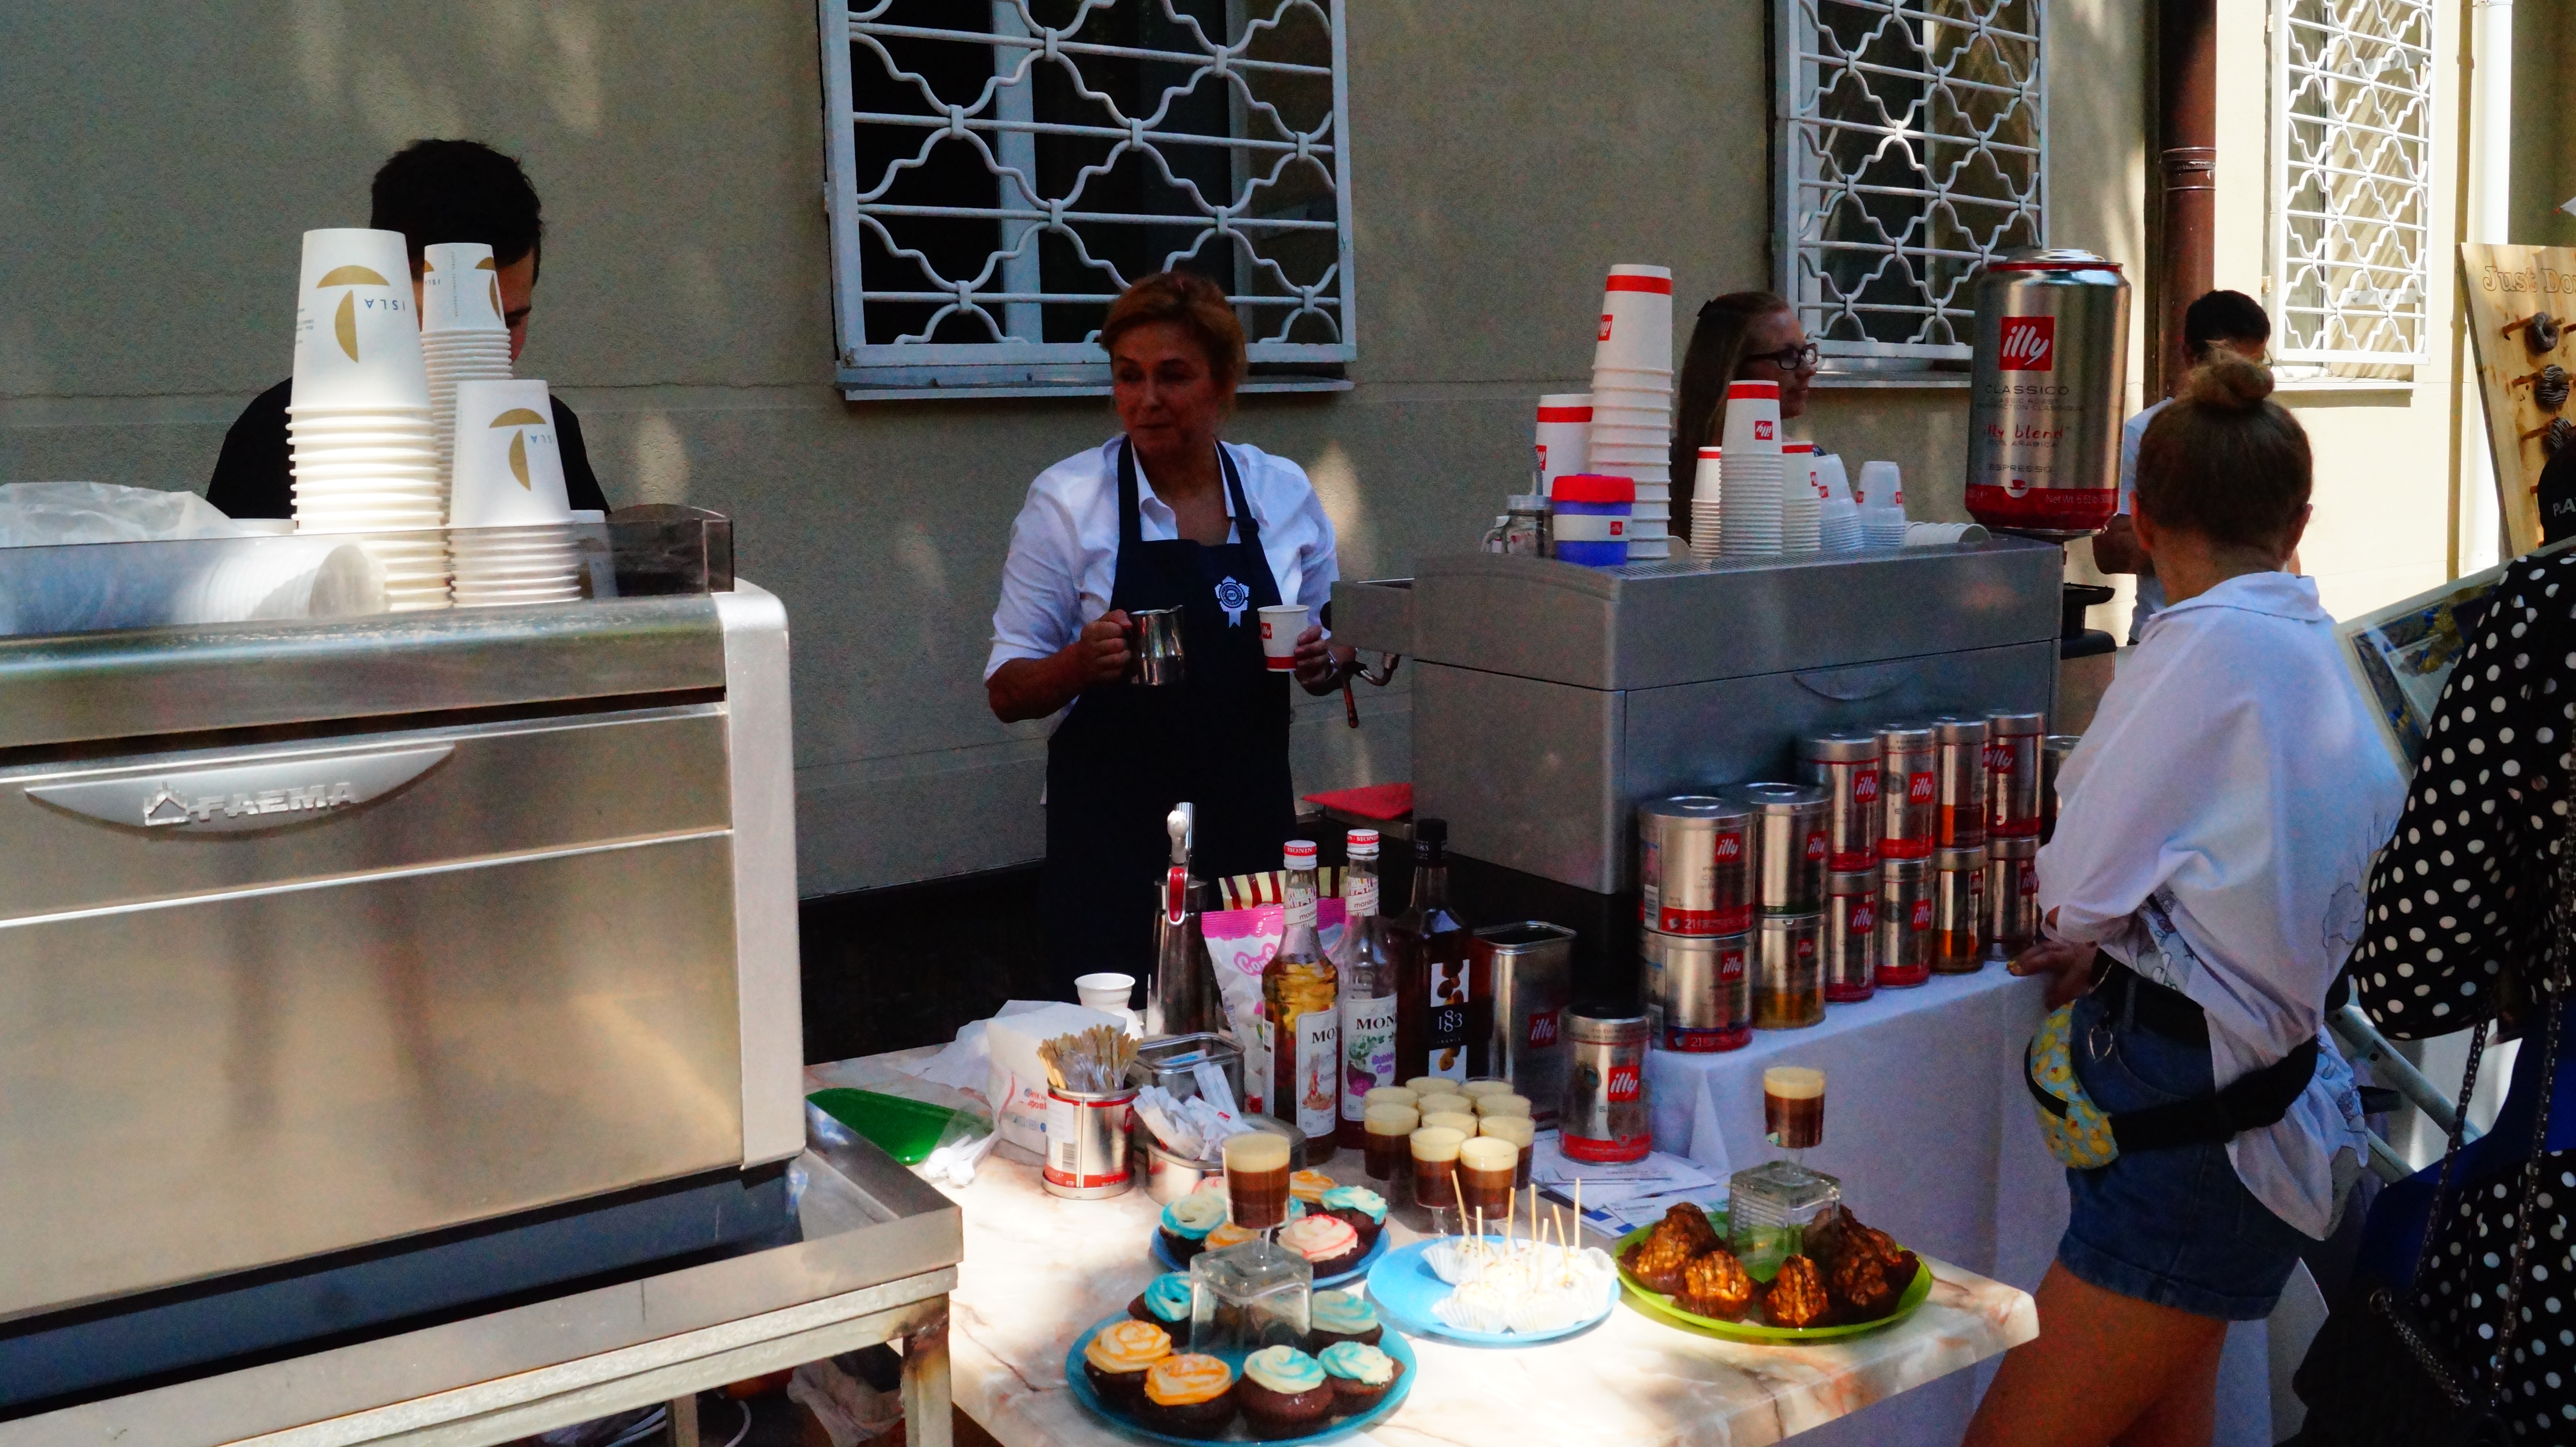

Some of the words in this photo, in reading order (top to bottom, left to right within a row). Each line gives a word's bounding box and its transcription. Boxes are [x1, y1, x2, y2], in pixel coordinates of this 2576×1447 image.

[2483, 266, 2538, 292] Just
[2541, 268, 2576, 294] Do
[364, 298, 406, 311] ISLA
[2002, 325, 2049, 366] illy
[1985, 384, 2069, 395] CLASSICO
[1756, 422, 1772, 437] illy
[2015, 424, 2064, 439] blend
[1989, 463, 2051, 472] ESPRESSO
[1856, 776, 1876, 799] illy
[1912, 777, 1932, 799] illy
[190, 782, 355, 822] FAEMA
[1717, 838, 1738, 858] illy
[1852, 907, 1874, 928] illy
[1723, 956, 1742, 976] illy
[1531, 1018, 1556, 1041] illy
[1610, 1072, 1638, 1098] illy
